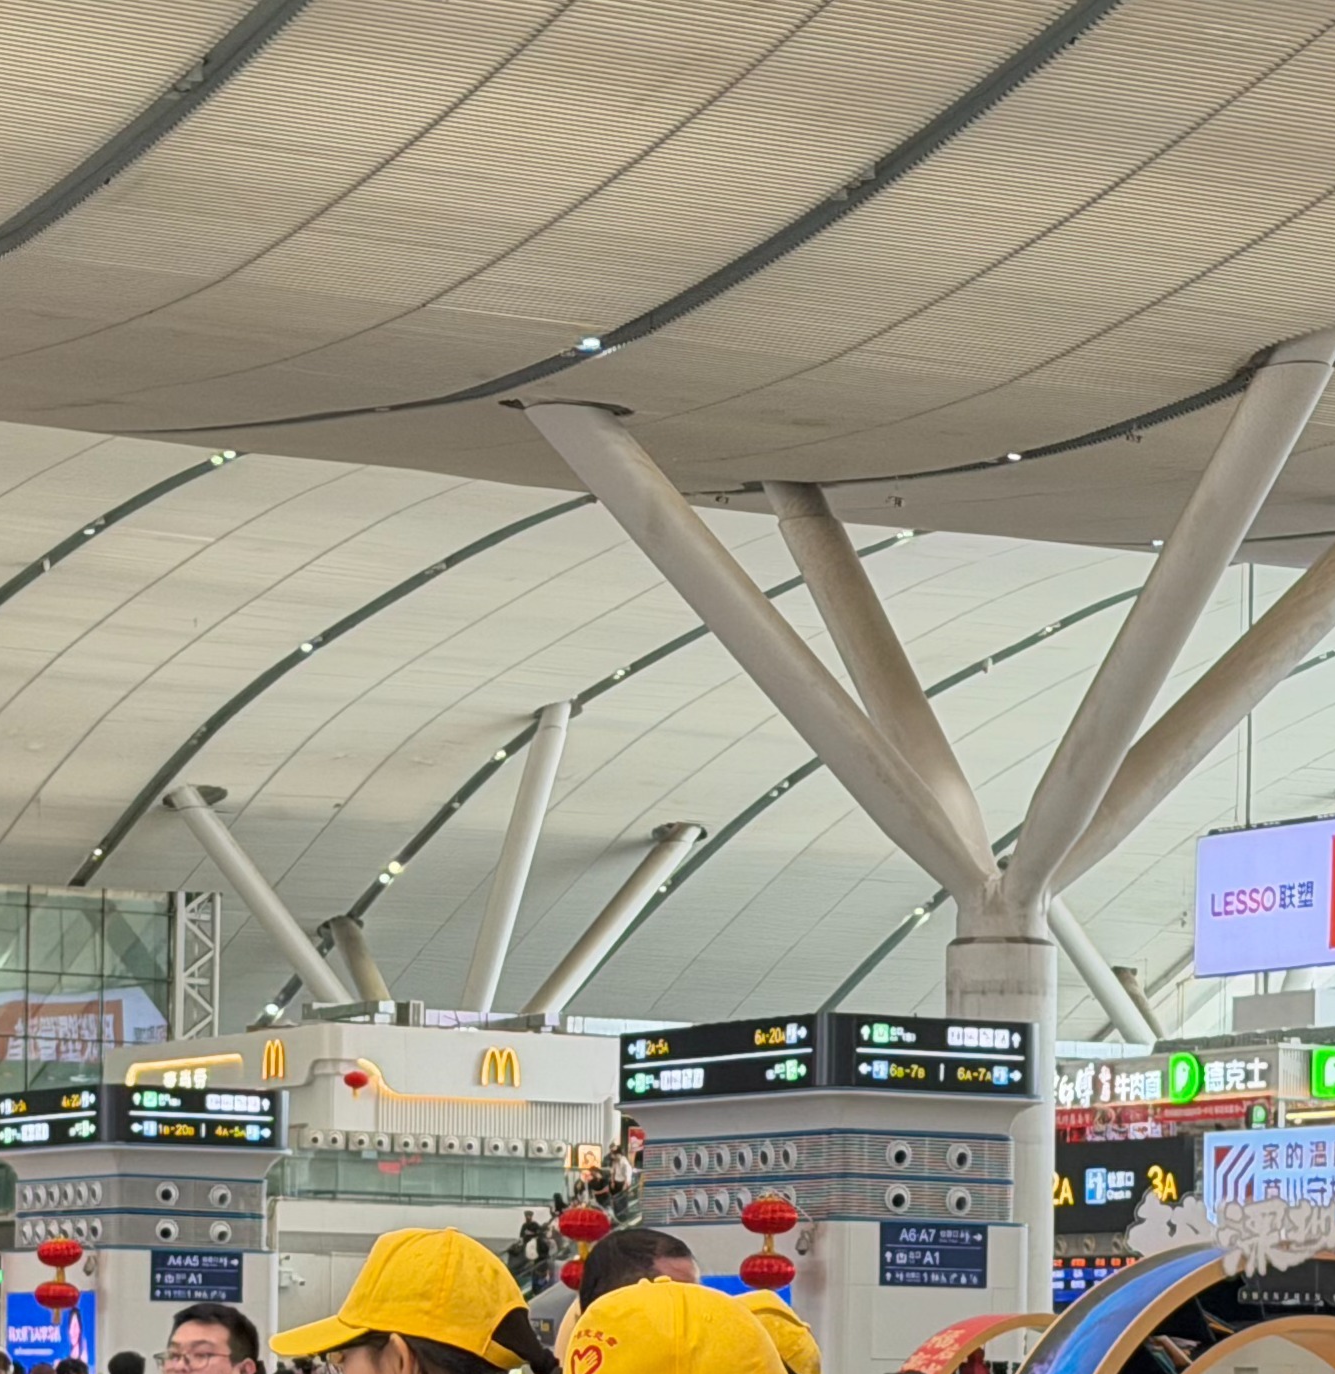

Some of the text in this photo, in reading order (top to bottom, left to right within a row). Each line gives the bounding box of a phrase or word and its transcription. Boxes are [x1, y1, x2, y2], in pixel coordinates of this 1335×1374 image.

[1204, 1057, 1268, 1092] 德克士
[1148, 1165, 1178, 1202] 3A
[923, 1250, 940, 1265] A1
